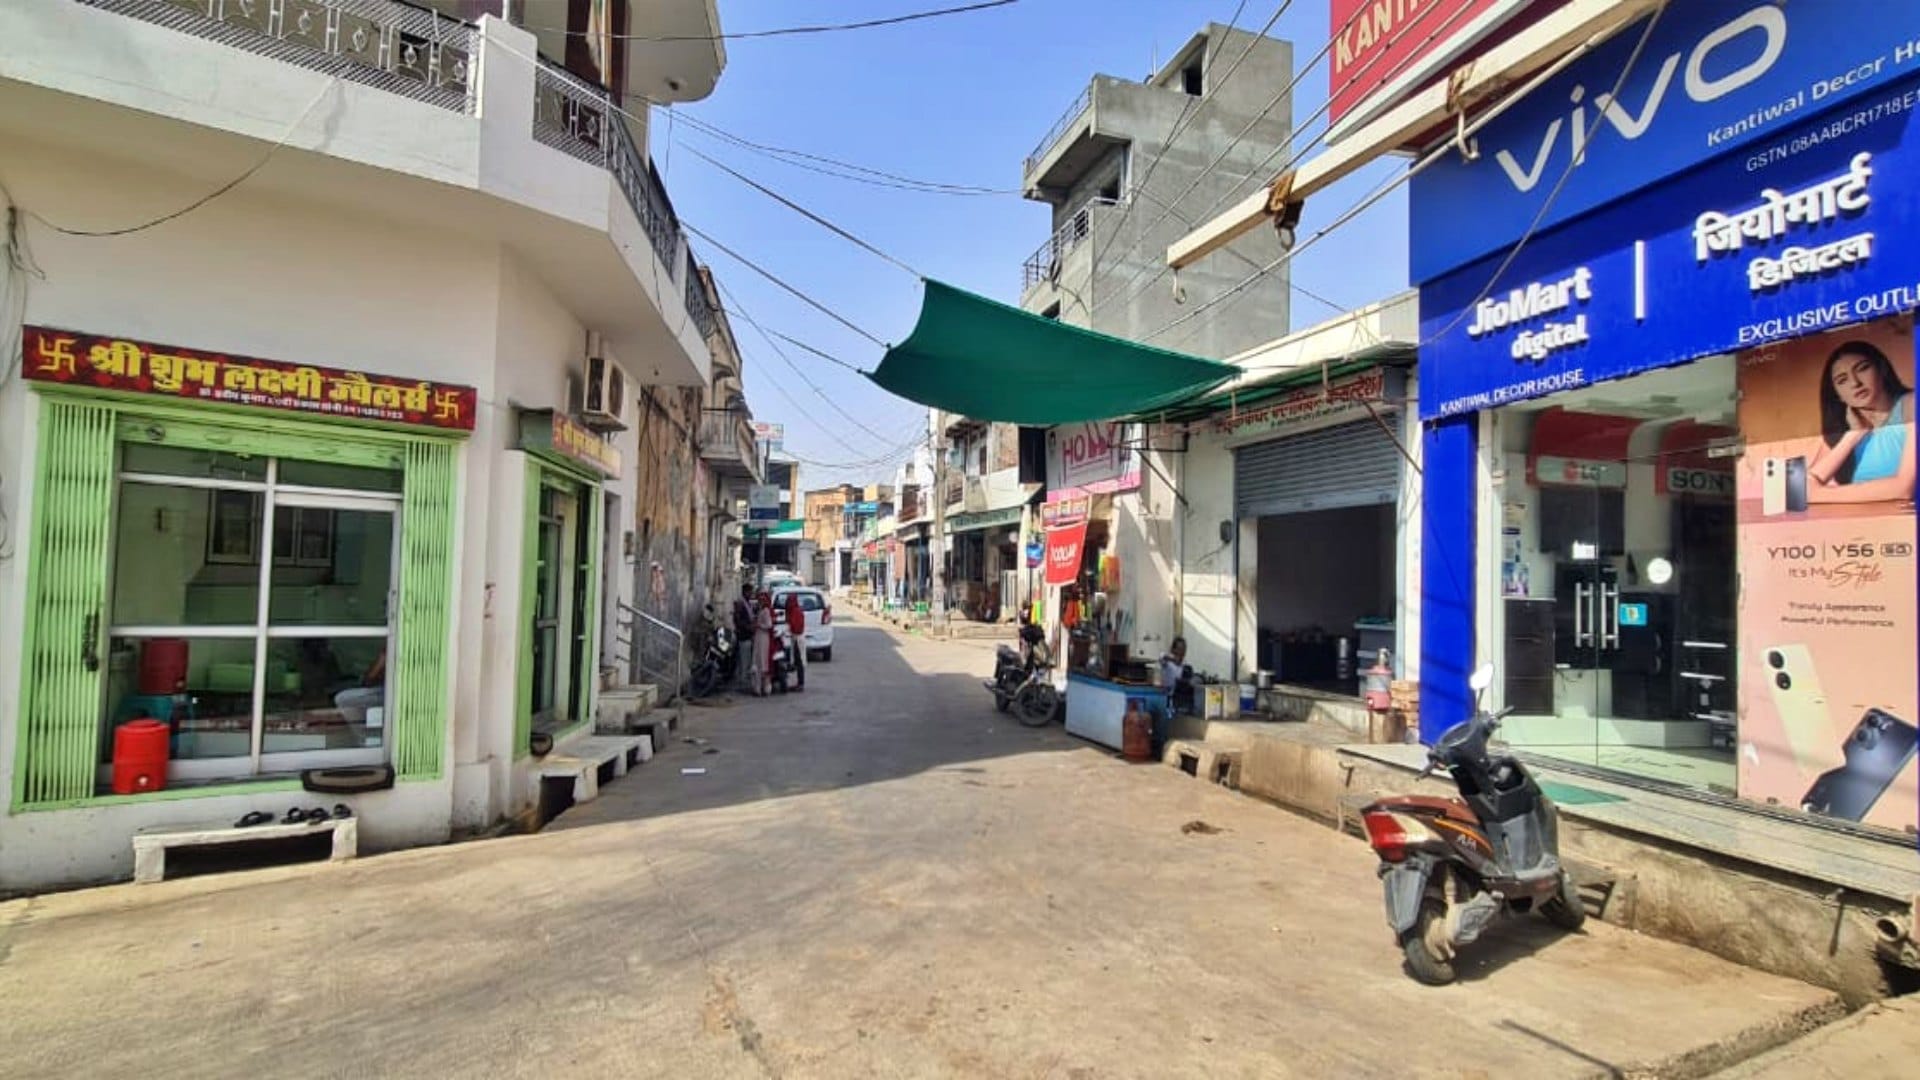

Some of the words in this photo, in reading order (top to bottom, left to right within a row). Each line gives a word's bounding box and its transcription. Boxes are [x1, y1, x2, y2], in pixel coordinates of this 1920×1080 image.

[1496, 5, 1787, 193] vivo
[1708, 90, 1804, 147] Kantiwal
[1811, 56, 1886, 102] Decor
[1746, 143, 1787, 172] GSTN
[1692, 151, 1873, 261] जियोमार्ट
[1747, 232, 1874, 290] डिजिटल
[1467, 266, 1593, 336] JioMart
[1738, 301, 1849, 343] EXCLUSIVE
[1511, 314, 1590, 360] digital
[88, 341, 145, 378] श्री
[149, 352, 219, 392] शुभ
[1440, 393, 1491, 414] KANTIWAL
[1494, 380, 1537, 402] DECOR
[1538, 368, 1586, 391] HOUSE
[1767, 544, 1816, 560] Y100
[1832, 543, 1875, 558] Y56
